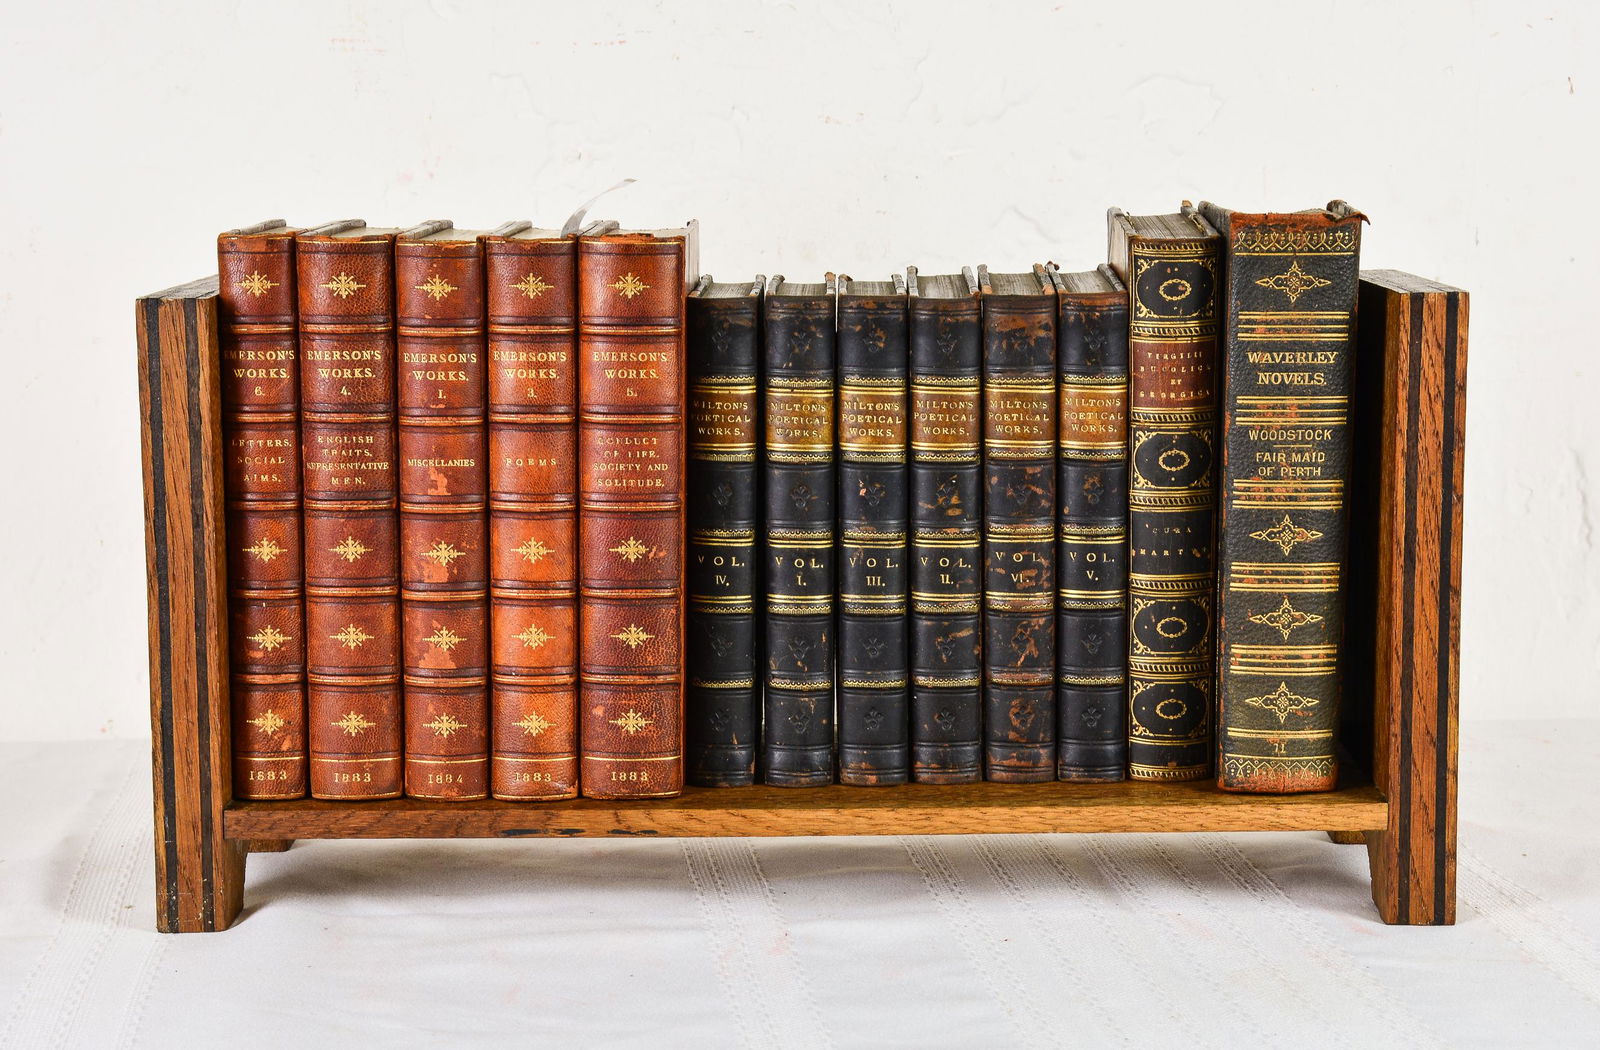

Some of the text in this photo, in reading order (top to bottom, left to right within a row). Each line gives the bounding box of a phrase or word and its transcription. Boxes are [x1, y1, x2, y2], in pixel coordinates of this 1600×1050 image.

[307, 349, 382, 361] EMERSON'S
[403, 351, 477, 364] EMERSON'S
[493, 350, 567, 362] EMERSON'S
[592, 350, 667, 362] EMERSON'S
[1247, 351, 1339, 364] WAVERLEY
[233, 368, 290, 379] WORKS.
[318, 367, 376, 379] WORKS.
[412, 369, 469, 381] WORKS.
[504, 367, 560, 380] WORKS.
[604, 368, 659, 380] WORKS.
[1257, 372, 1327, 385] NOVELS.
[340, 385, 352, 396] 4.
[527, 387, 538, 398] 3.
[693, 400, 748, 410] MILTON'S
[771, 402, 826, 412] MILTON'S
[844, 401, 900, 411] MILTON'S
[916, 399, 974, 409] MILTON'S
[989, 399, 1048, 409] MILTON'S
[1065, 397, 1121, 407] MILTON'S
[841, 413, 902, 424] POETICAL
[913, 412, 976, 422] POETICAL
[988, 411, 1049, 422] POETICAL
[1064, 410, 1123, 420] POETICAL
[849, 427, 895, 438] WORKS.
[923, 426, 970, 436] WORKS.
[995, 424, 1043, 435] WORKS.
[1071, 423, 1117, 433] WORKS.
[317, 435, 374, 444] ENGLISH
[1248, 429, 1332, 441] WOODSTOCK
[597, 437, 659, 445] CONDUCT
[322, 448, 373, 457] TRAITS.
[604, 450, 619, 458] OF
[1255, 452, 1326, 463] FAIR MAID
[237, 455, 286, 465] SOCIAL
[407, 458, 475, 467] MISCELLANIES
[505, 457, 558, 467] POEMS
[306, 461, 389, 471] REPRESENTATIVE
[593, 463, 669, 471] SOCIETY AND
[1258, 466, 1321, 477] OF PERTH
[331, 476, 366, 485] MEN.
[775, 556, 824, 568] VOL.
[849, 557, 899, 568] VOL.
[920, 557, 972, 569] VOL.
[1069, 552, 1115, 563] VOL.
[866, 575, 886, 587] III.
[939, 574, 954, 585] II.
[1086, 571, 1099, 581] V.
[249, 770, 287, 781] 1883
[334, 772, 371, 783] 1883
[428, 774, 463, 784] 1884
[515, 772, 552, 783] 1883
[611, 771, 649, 782] 1883
